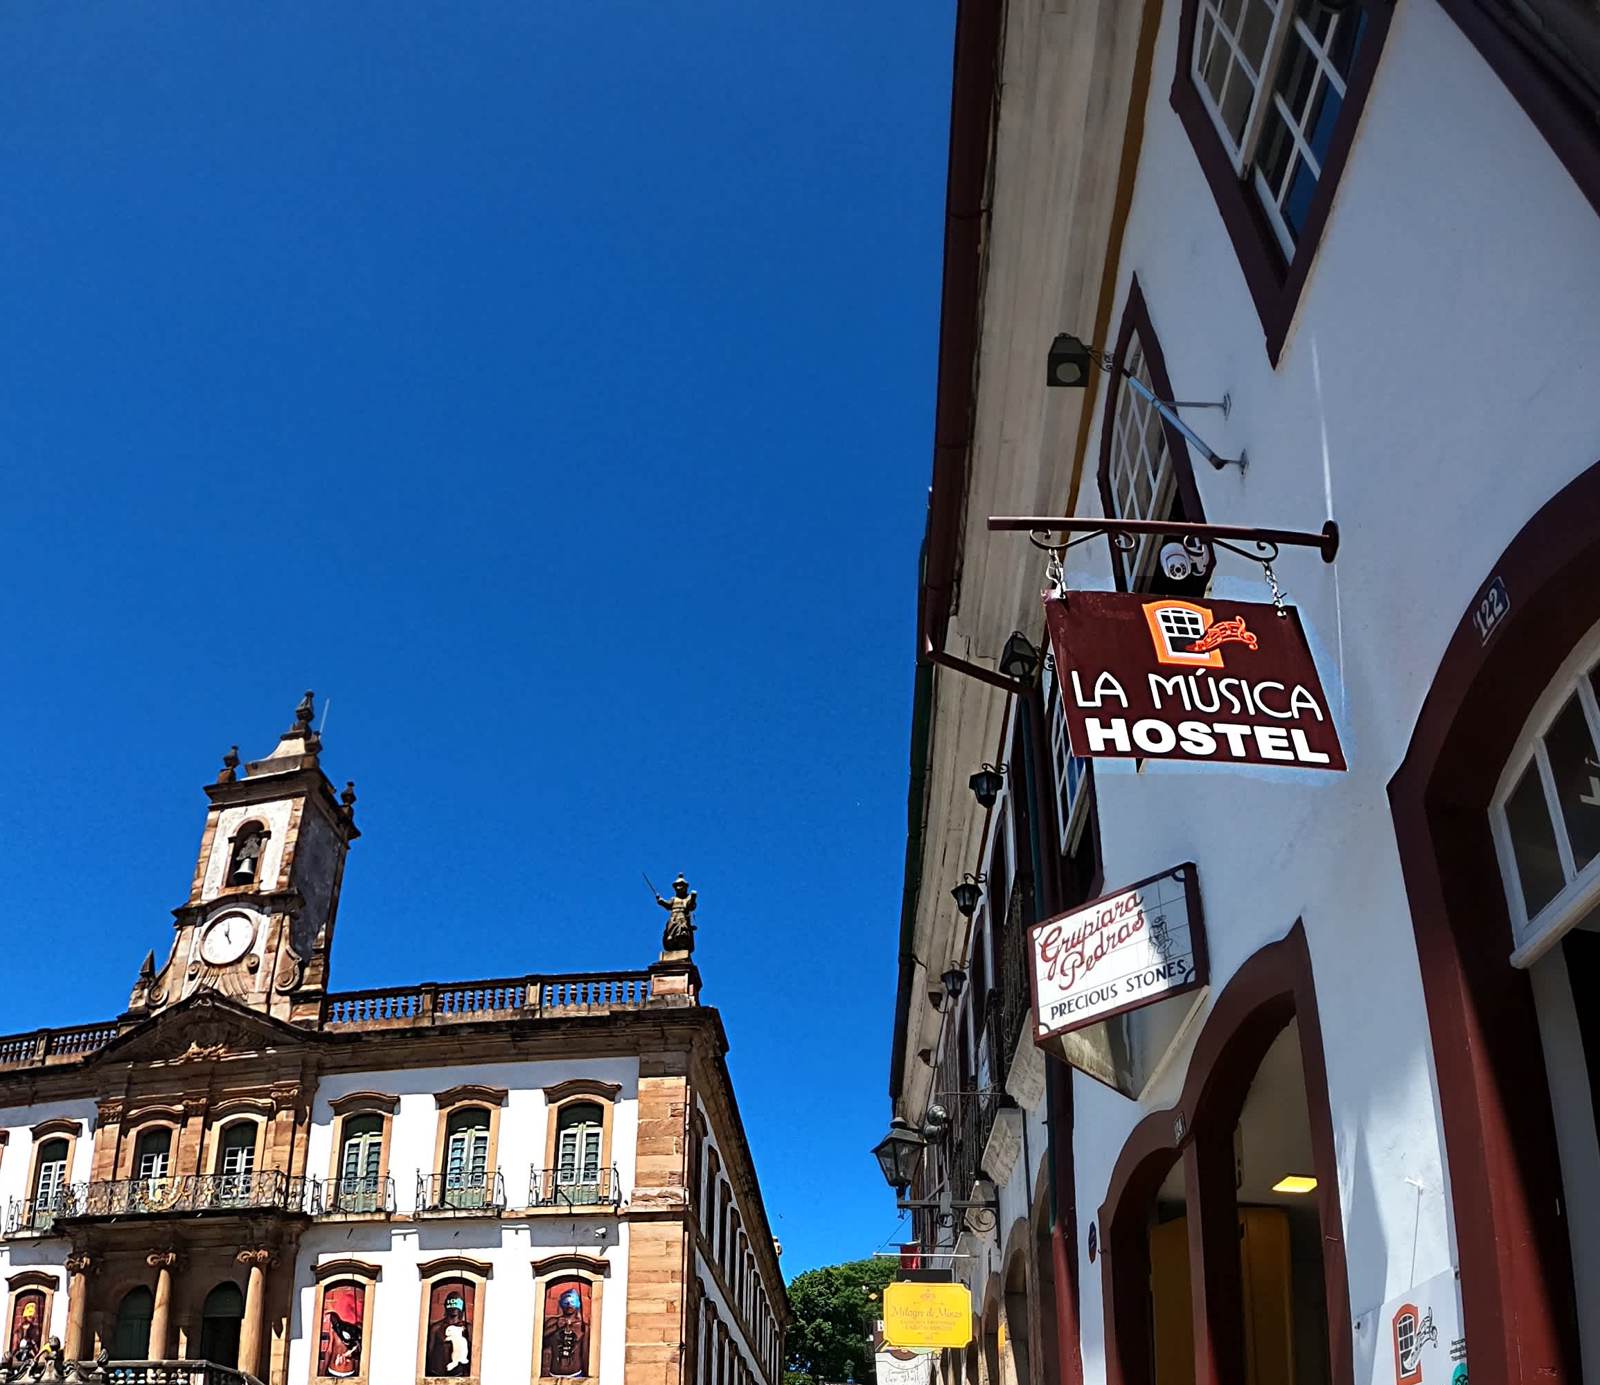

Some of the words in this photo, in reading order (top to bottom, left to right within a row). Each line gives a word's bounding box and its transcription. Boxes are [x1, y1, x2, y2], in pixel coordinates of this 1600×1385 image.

[1475, 588, 1503, 637] 122
[1070, 670, 1128, 708] LA
[1148, 668, 1324, 721] MÚSICA
[1084, 717, 1330, 764] HOSTEL
[1040, 891, 1144, 981] Grupiara
[1058, 909, 1145, 991] Pedras
[1050, 983, 1118, 1020] PRECIOUS
[1126, 960, 1187, 993] STONES
[926, 1306, 936, 1318] de
